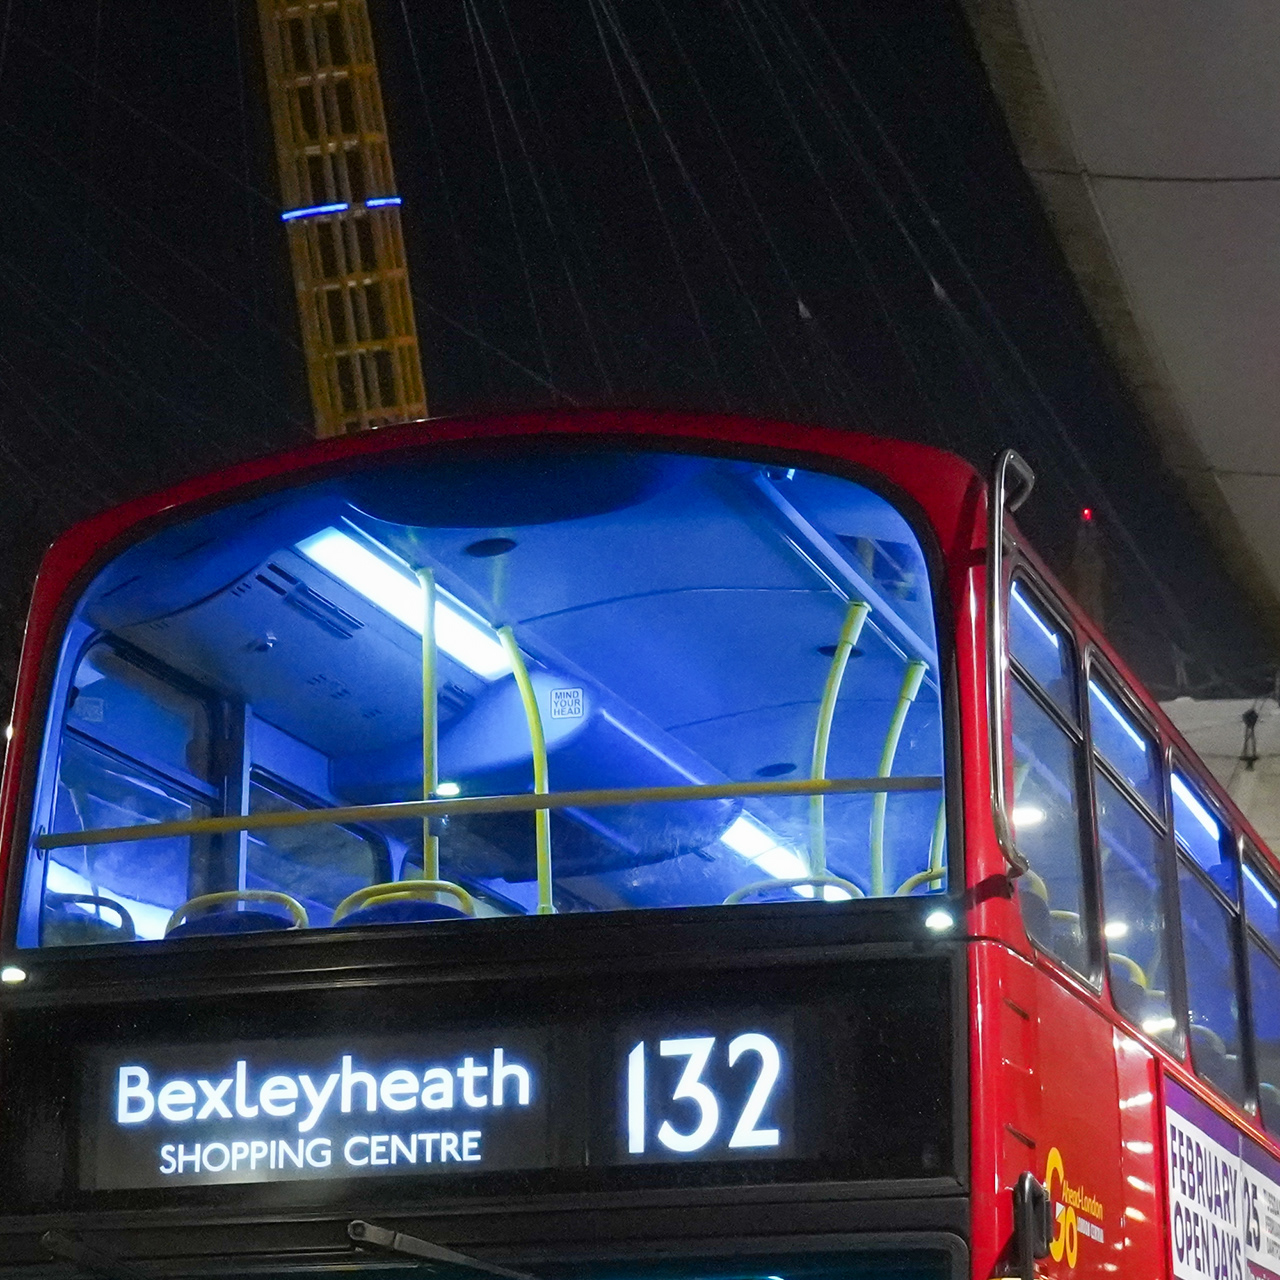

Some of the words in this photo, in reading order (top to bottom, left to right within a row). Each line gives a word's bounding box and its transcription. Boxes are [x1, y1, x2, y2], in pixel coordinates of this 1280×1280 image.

[553, 699, 581, 707] YOUR
[553, 707, 581, 716] HEAD
[555, 690, 579, 699] MIND
[116, 1047, 530, 1133] Bexleyheath
[628, 1032, 780, 1154] 132
[159, 1138, 331, 1175] SHOPPING
[343, 1130, 482, 1167] CENTRE
[1169, 1123, 1238, 1228] FEBRUARY
[1173, 1199, 1211, 1276] OPEN
[1243, 1176, 1261, 1253] 25
